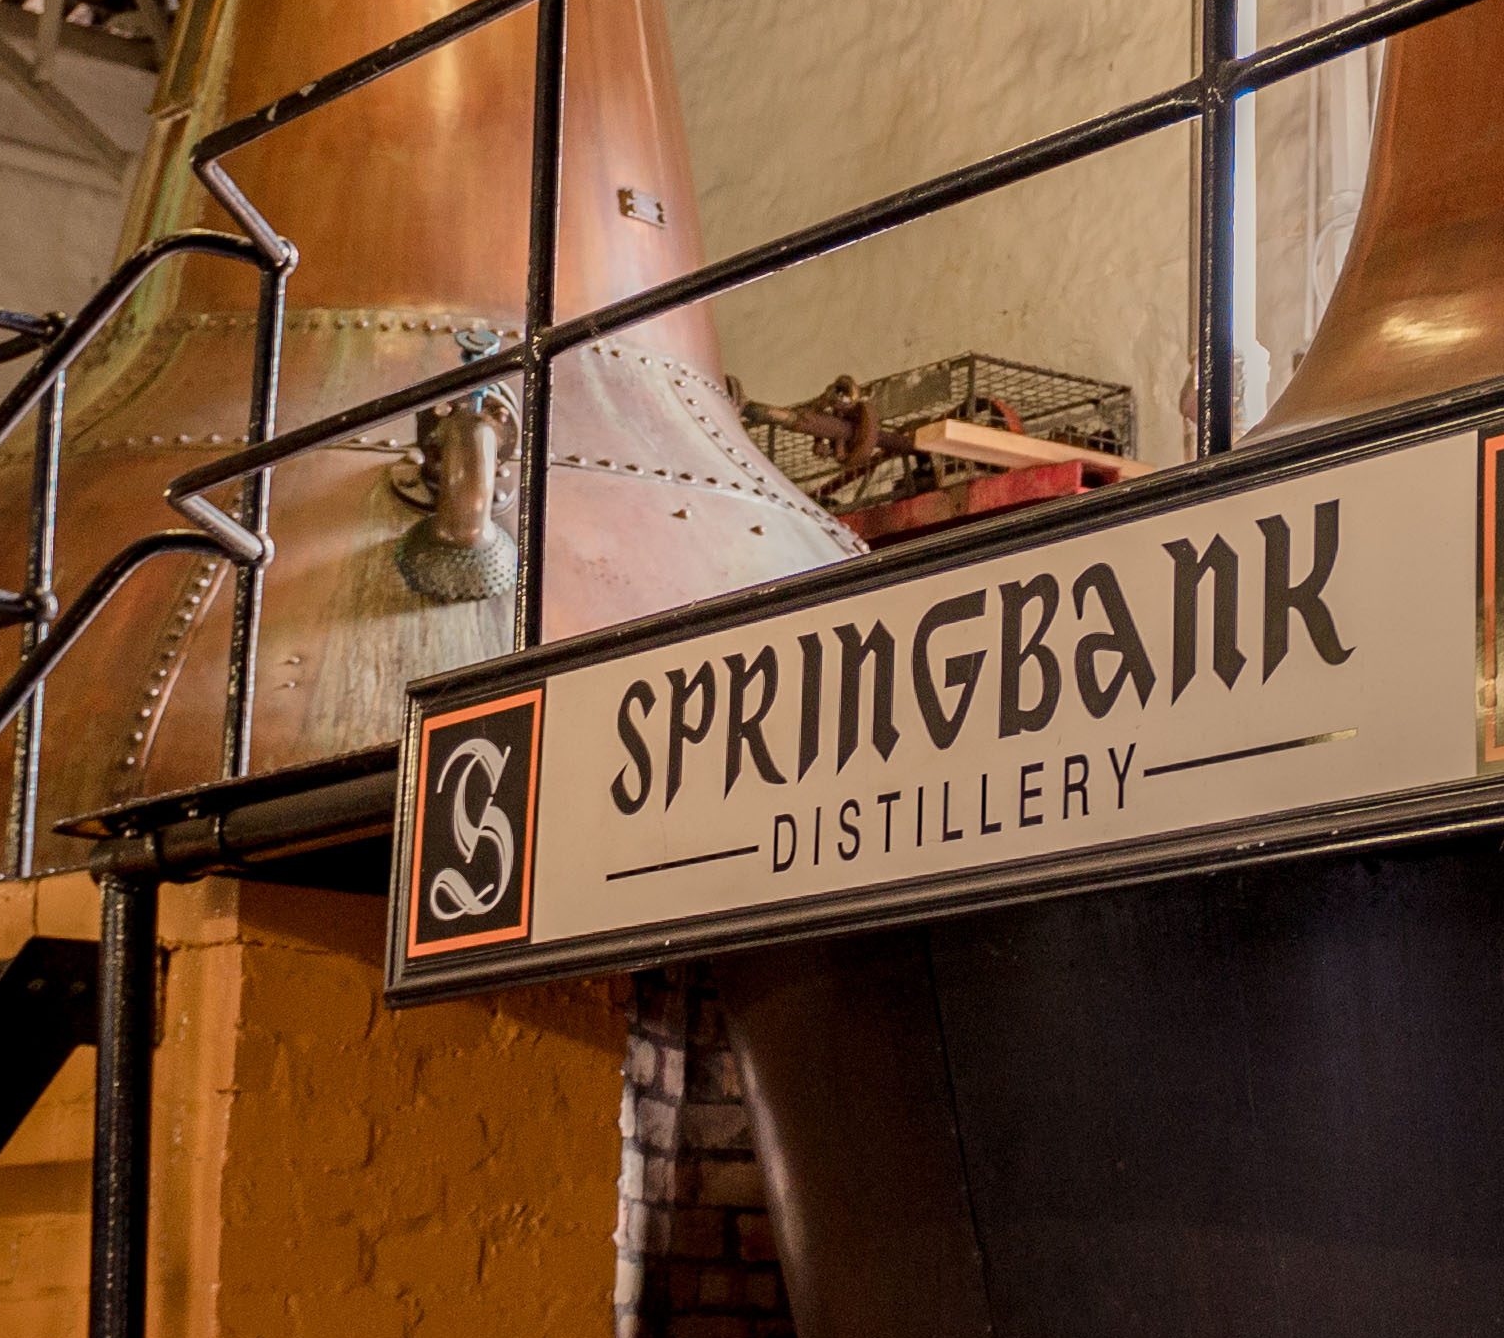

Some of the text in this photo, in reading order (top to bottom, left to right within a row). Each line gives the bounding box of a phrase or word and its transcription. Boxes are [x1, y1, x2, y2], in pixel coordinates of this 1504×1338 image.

[609, 498, 1357, 816] SPRINGBANK
[430, 737, 515, 922] S
[772, 742, 1137, 873] DISTILLERY
